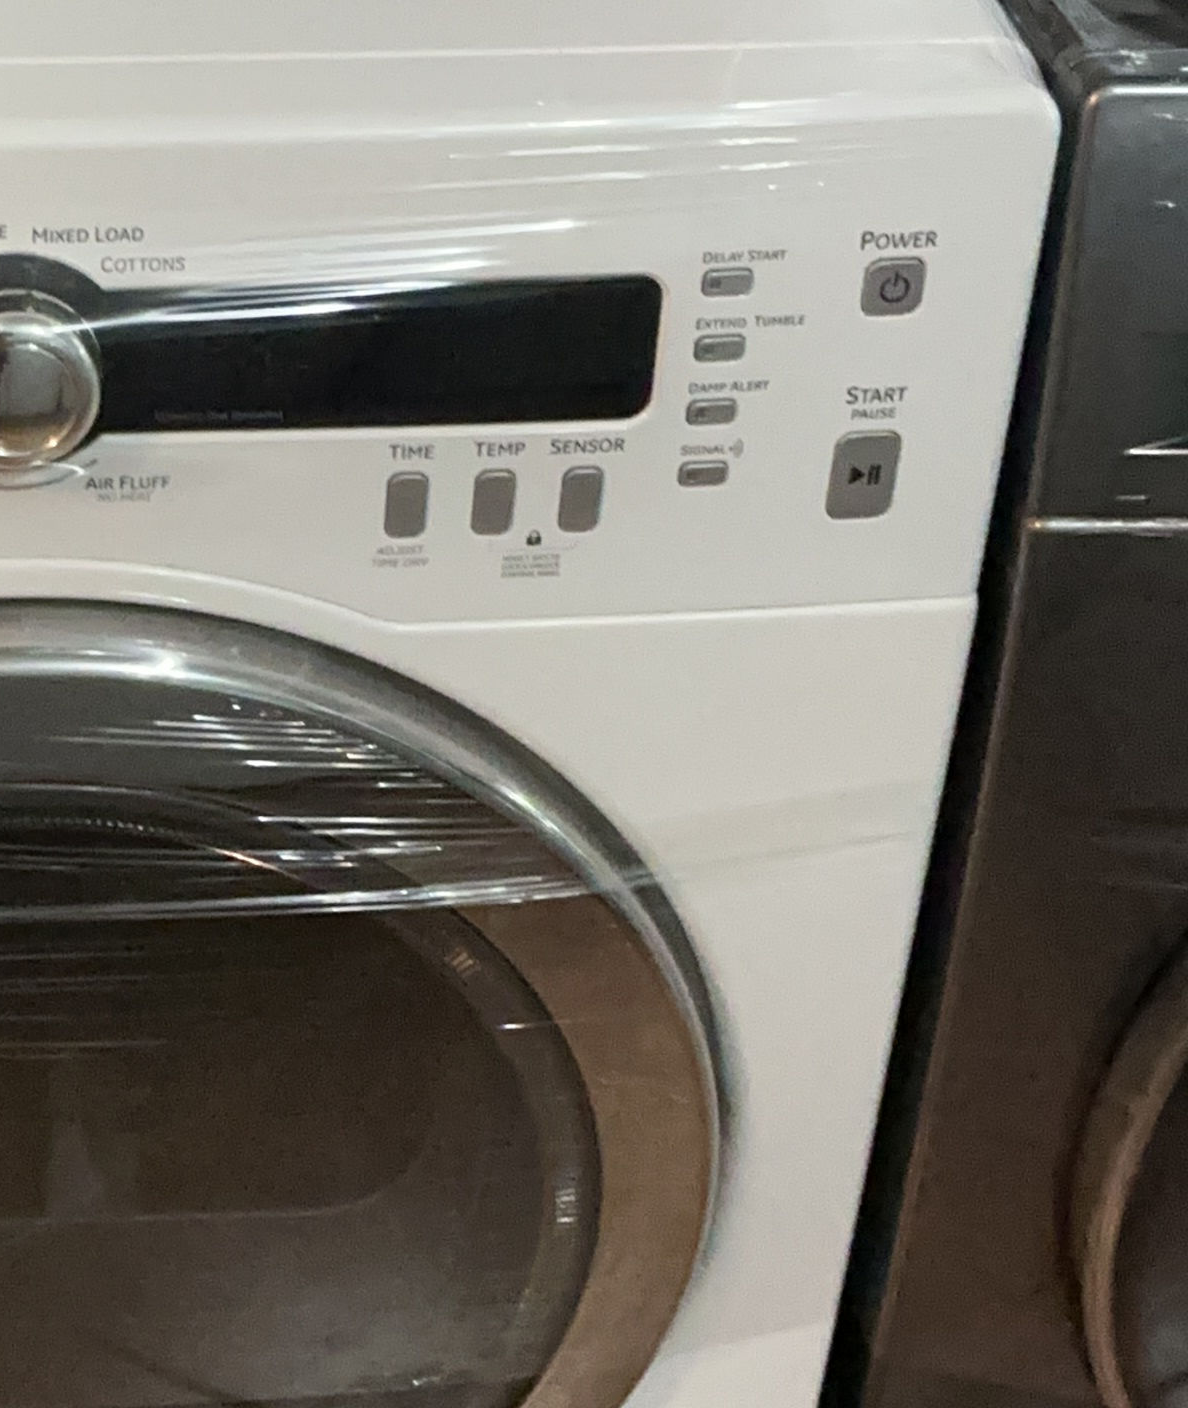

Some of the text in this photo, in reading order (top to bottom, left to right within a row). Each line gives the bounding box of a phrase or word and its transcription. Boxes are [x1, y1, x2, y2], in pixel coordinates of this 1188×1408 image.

[31, 226, 144, 244] MIXED LOAD
[860, 230, 938, 250] POWER
[702, 249, 786, 264] DELAY START
[101, 257, 186, 274] COTTONS
[695, 314, 805, 330] EXTEND TUMBLE
[688, 381, 769, 395] DAMP ALERT
[845, 387, 907, 405] START
[850, 407, 897, 420] PAUSE
[389, 443, 435, 461] TIME
[474, 441, 526, 458] TEMP
[550, 438, 625, 456] SENSOR
[680, 444, 726, 457] SIGNAL
[85, 474, 170, 490] AIR FLUFF
